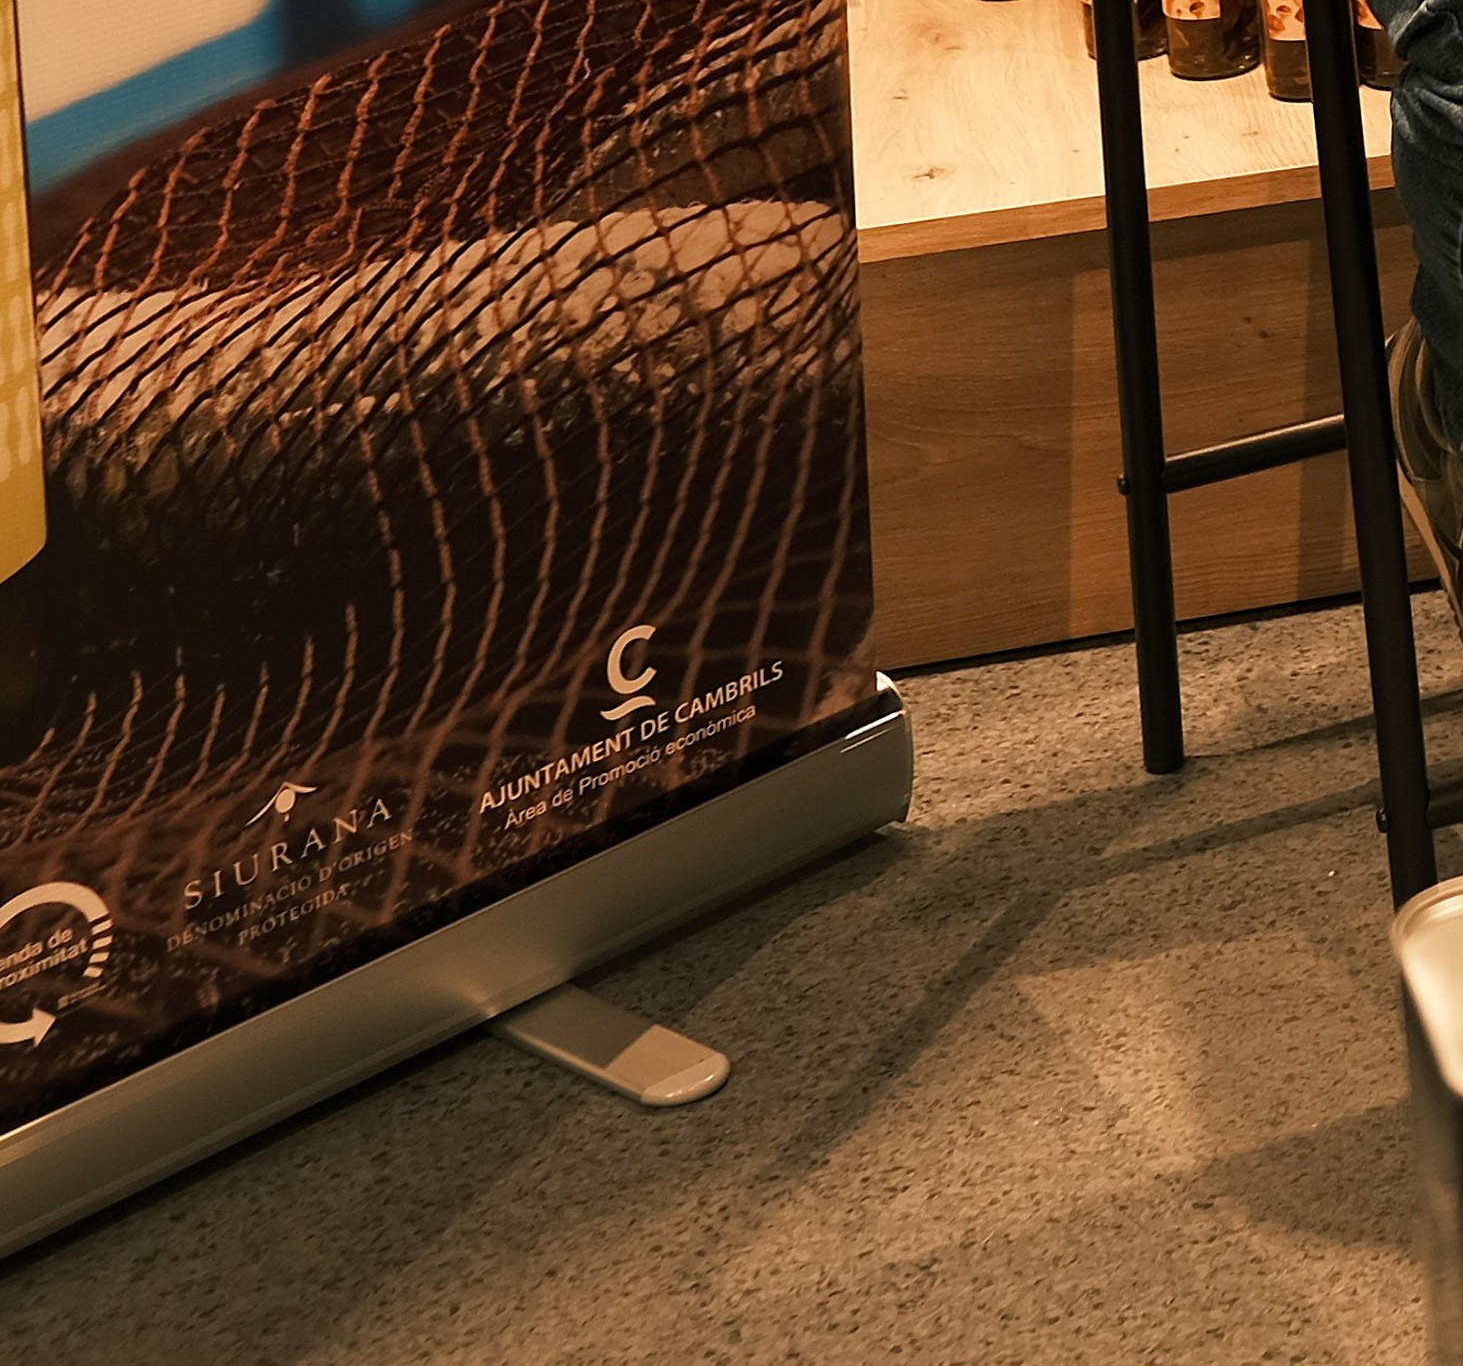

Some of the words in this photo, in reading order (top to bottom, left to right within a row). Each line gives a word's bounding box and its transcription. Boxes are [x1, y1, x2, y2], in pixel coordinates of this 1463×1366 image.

[478, 726, 636, 815] AJUNTAMENT
[640, 710, 671, 742] DE
[674, 660, 785, 725] CAMBRILS
[504, 798, 548, 831] Àrea
[551, 785, 574, 808] de
[578, 745, 661, 796] Promoció
[664, 703, 757, 756] econòmica
[183, 797, 394, 911] SIURANA
[0, 940, 44, 973] enda
[47, 927, 74, 950] de
[238, 882, 351, 947] PROTEGIDA
[0, 937, 90, 991] roximitat
